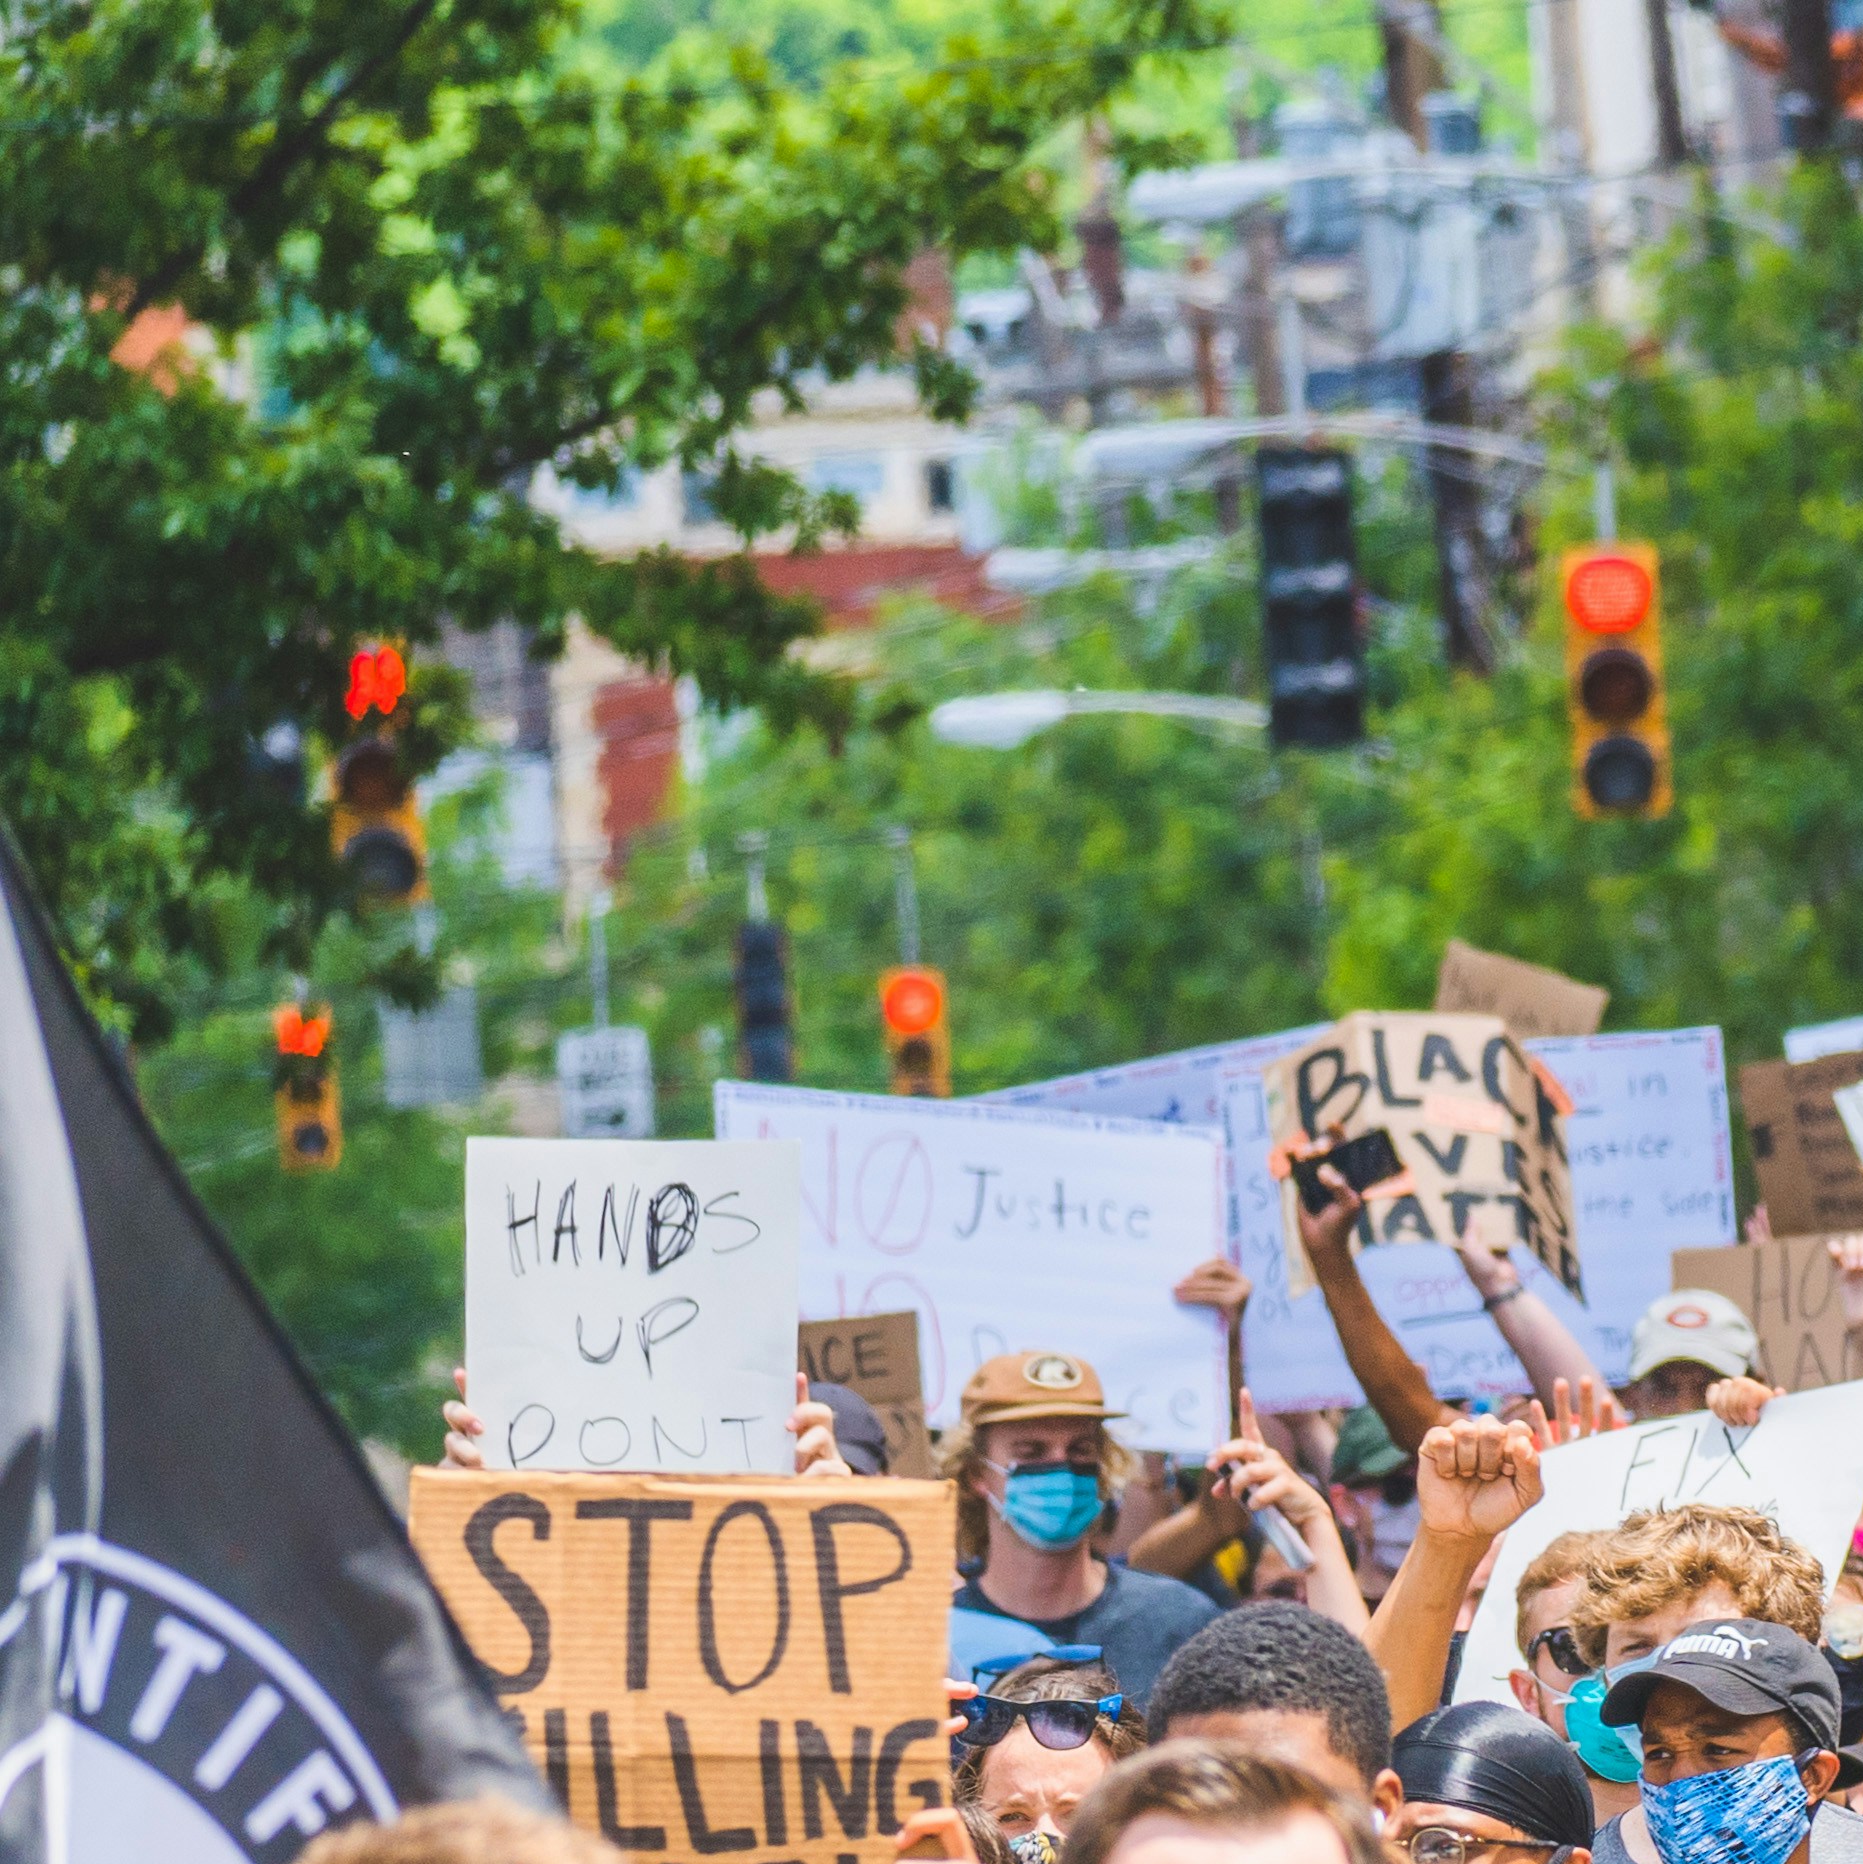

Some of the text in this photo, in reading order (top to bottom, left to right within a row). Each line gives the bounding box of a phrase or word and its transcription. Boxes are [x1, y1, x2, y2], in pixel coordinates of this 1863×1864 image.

[953, 1163, 1152, 1240] Justice
[575, 1296, 699, 1379] UP
[1621, 1420, 1760, 1510] FIX
[464, 1491, 913, 1697] STOP
[1663, 1634, 1740, 1660] PUMA
[506, 1706, 943, 1855] ILLING
